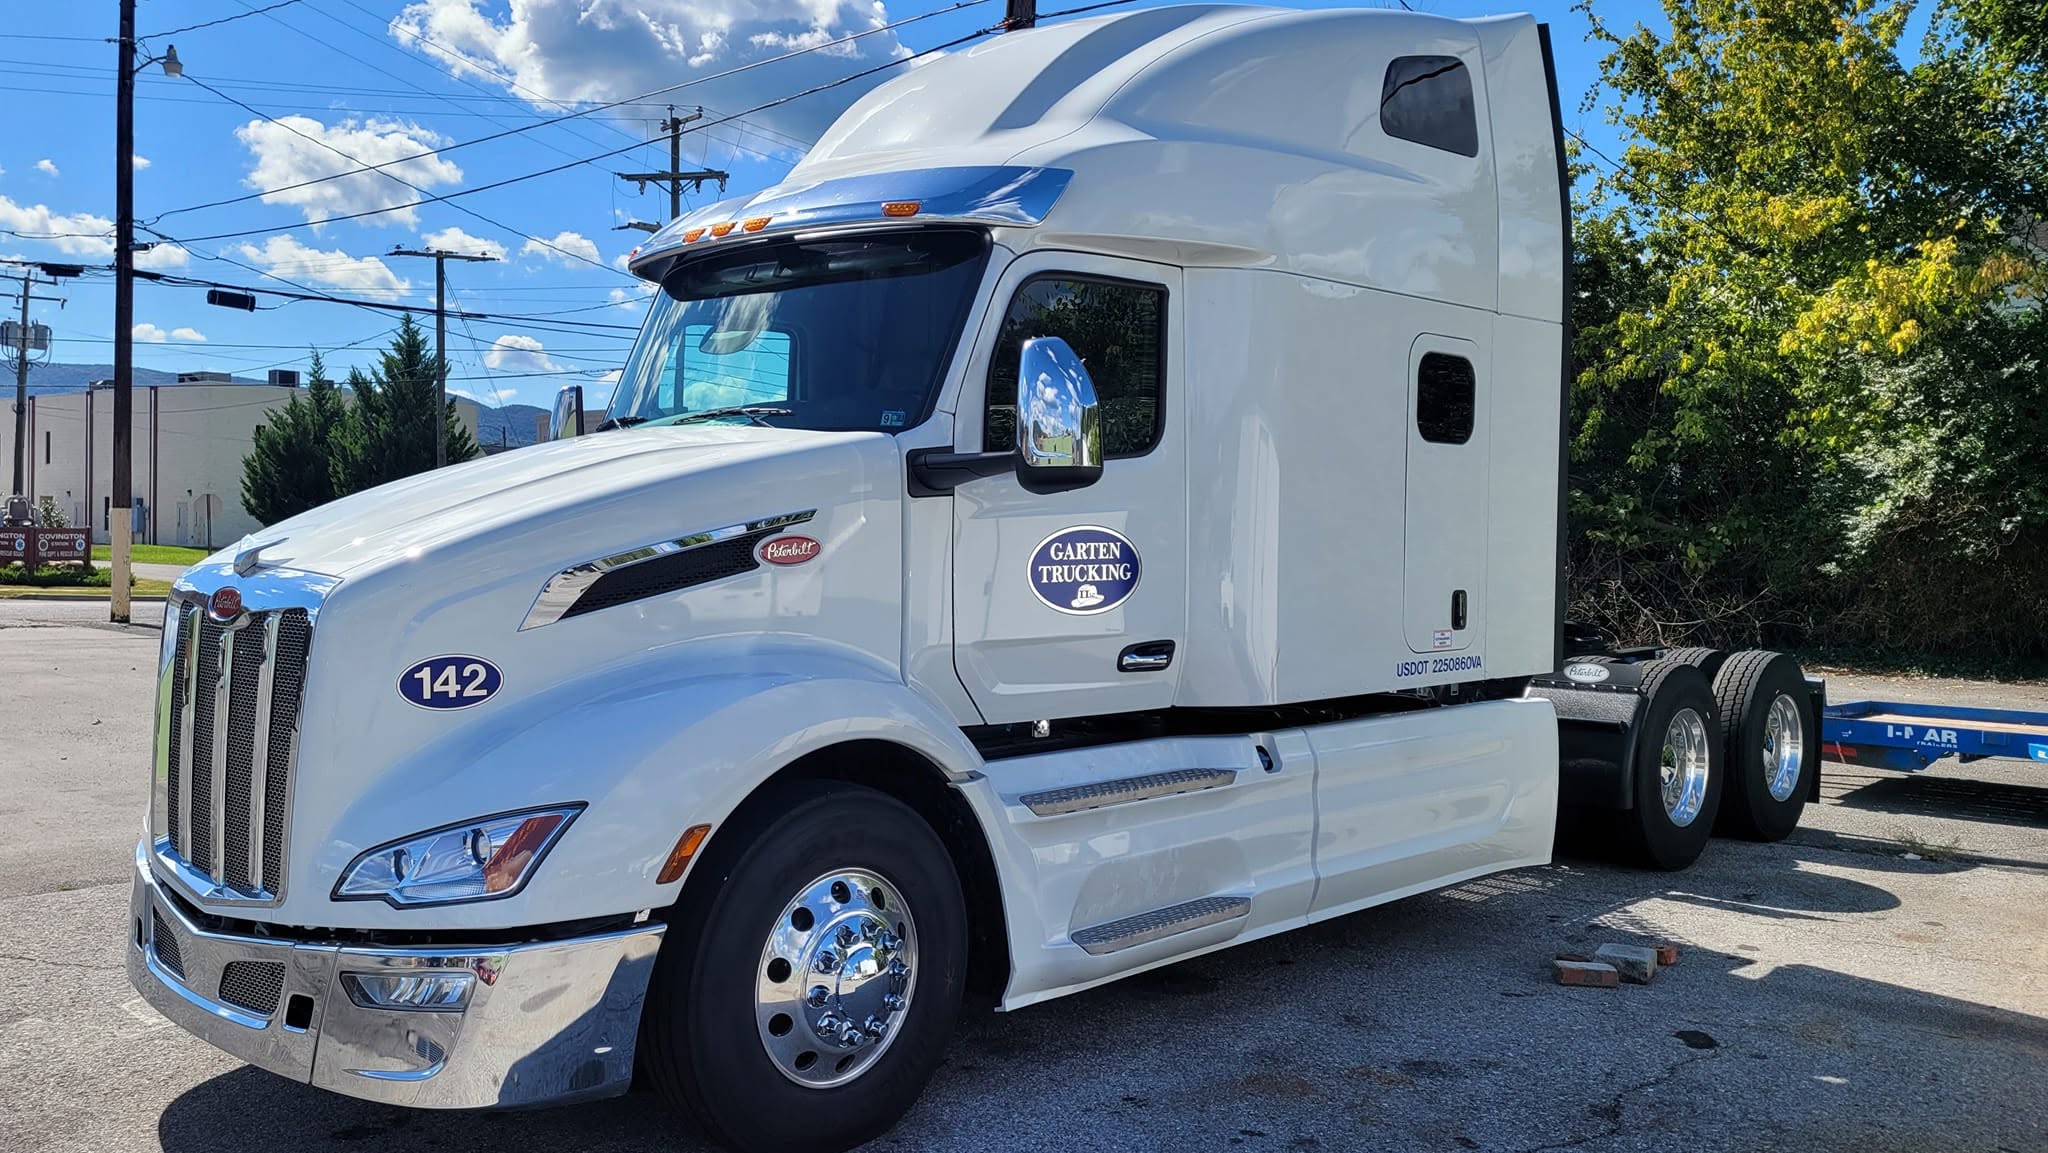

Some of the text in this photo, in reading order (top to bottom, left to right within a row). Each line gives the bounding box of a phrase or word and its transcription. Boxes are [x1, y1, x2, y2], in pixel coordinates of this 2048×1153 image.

[767, 542, 816, 560] Peterbilt
[1050, 542, 1122, 561] GARTEN
[1038, 563, 1132, 583] TRUCKING
[1397, 655, 1482, 677] USDOT 2250860VA
[1570, 665, 1605, 677] Peterbilt
[414, 663, 488, 700] 142
